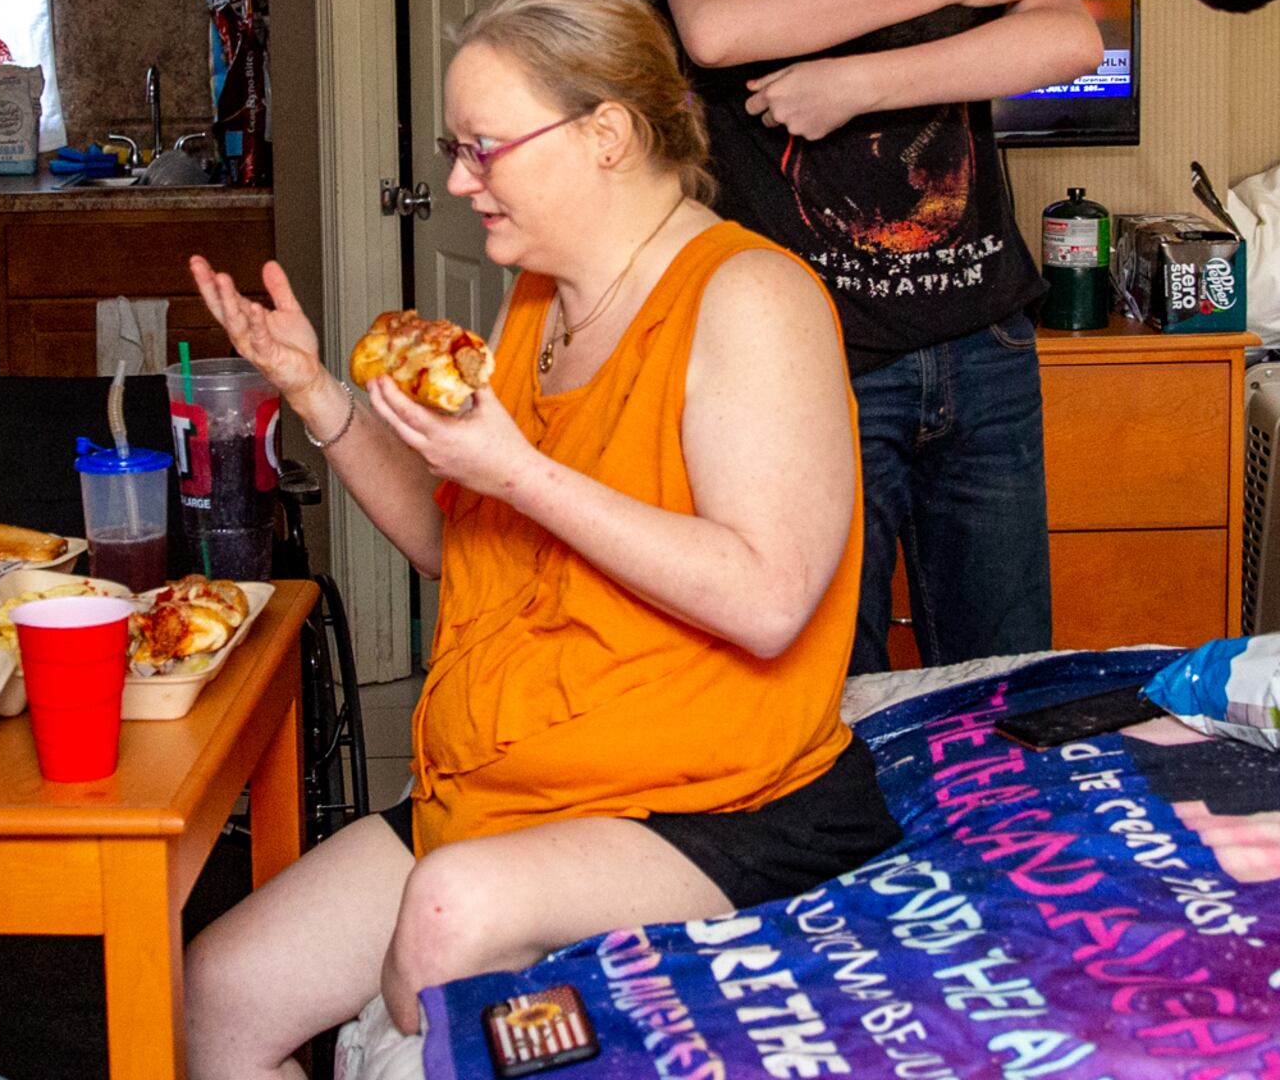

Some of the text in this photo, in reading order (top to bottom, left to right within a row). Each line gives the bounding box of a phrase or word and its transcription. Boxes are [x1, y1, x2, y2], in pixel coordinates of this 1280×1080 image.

[1100, 58, 1127, 67] HLN
[1170, 264, 1182, 309] SUGAR
[1181, 263, 1196, 309] zero
[1205, 264, 1231, 305] Pepper
[1222, 275, 1235, 294] Dr
[735, 991, 852, 1079] THE
